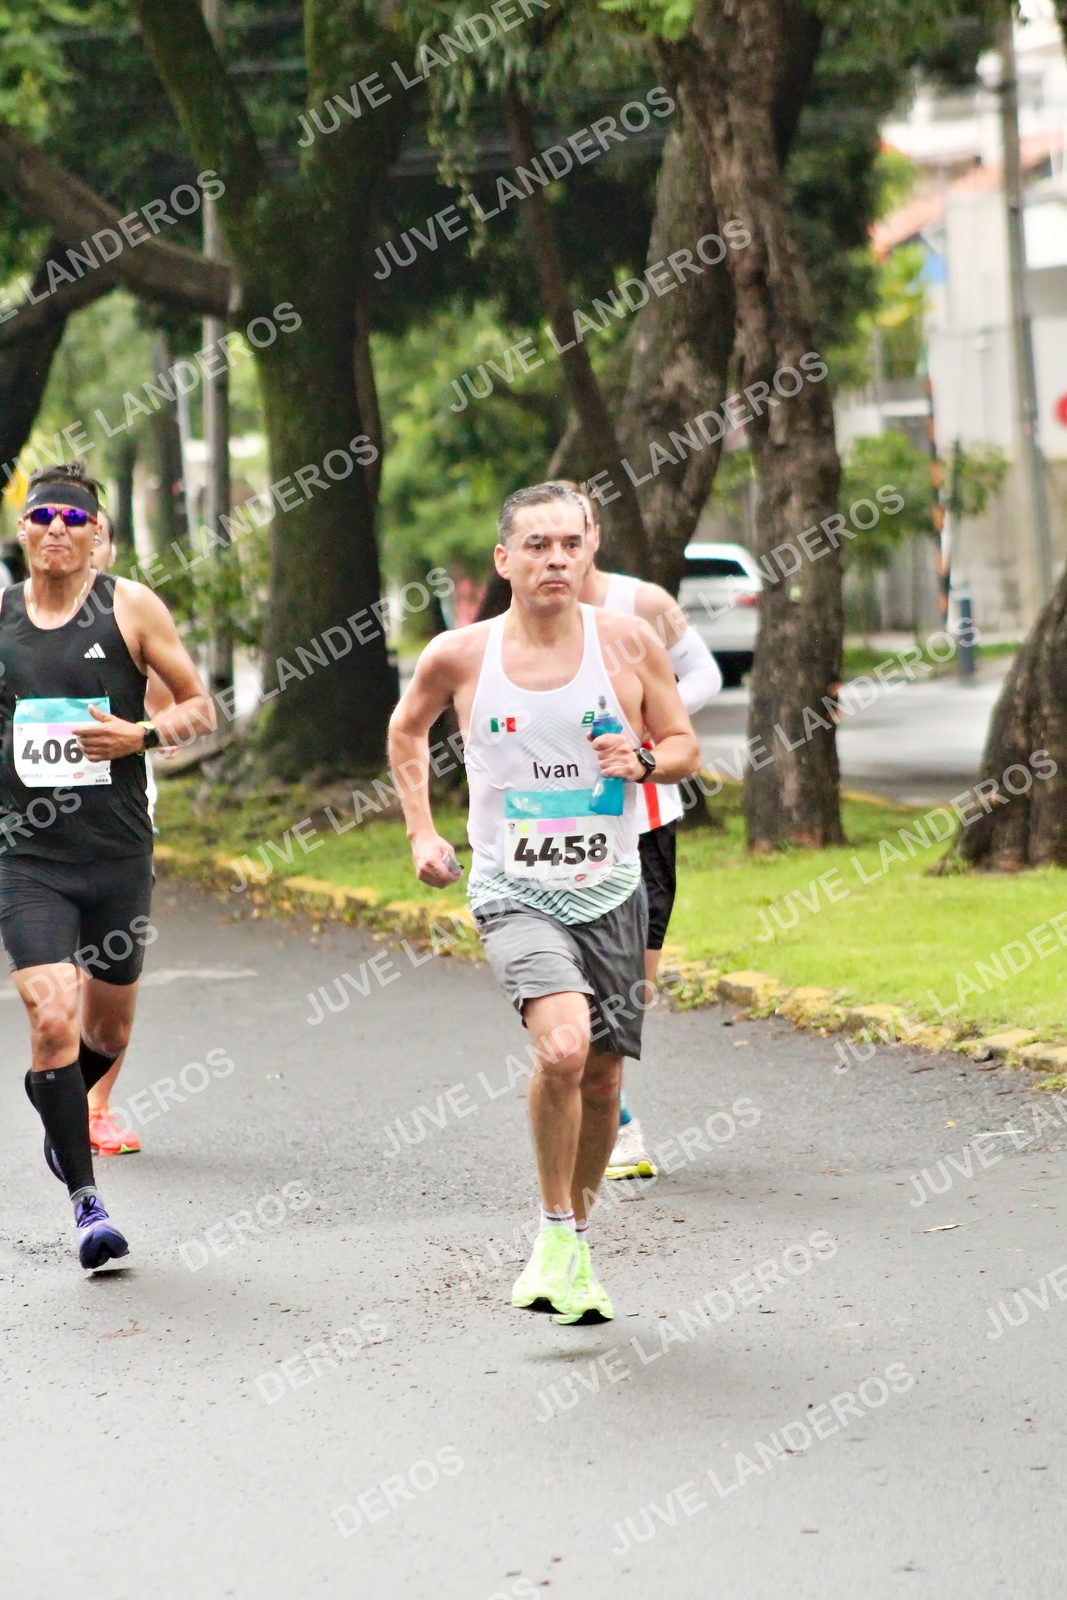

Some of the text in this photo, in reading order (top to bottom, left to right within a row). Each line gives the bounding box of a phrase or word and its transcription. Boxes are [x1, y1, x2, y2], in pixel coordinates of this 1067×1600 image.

[21, 738, 85, 765] 406
[532, 761, 580, 780] Ivan
[513, 832, 608, 868] 4458
